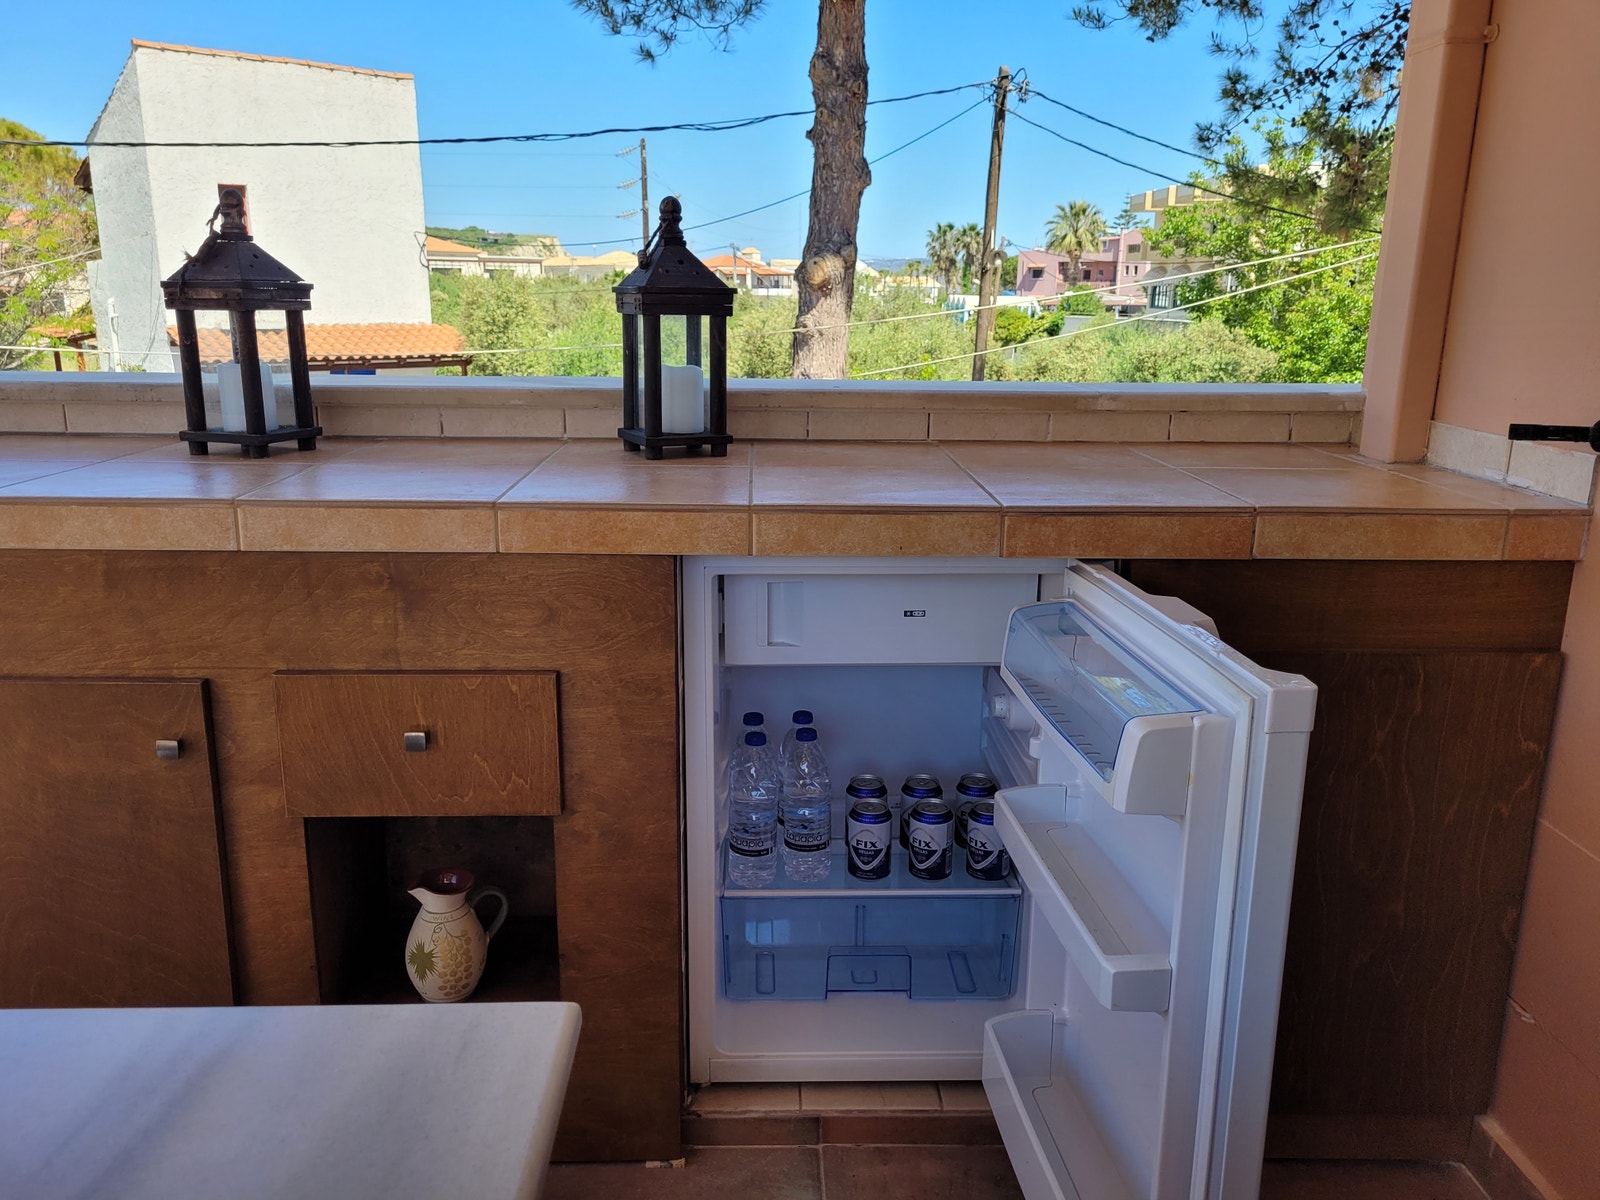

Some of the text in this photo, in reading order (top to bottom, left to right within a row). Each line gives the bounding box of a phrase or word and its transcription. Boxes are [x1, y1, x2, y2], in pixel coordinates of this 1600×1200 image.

[856, 838, 879, 849] FIX
[912, 836, 932, 849] FIX
[969, 836, 988, 849] FIX
